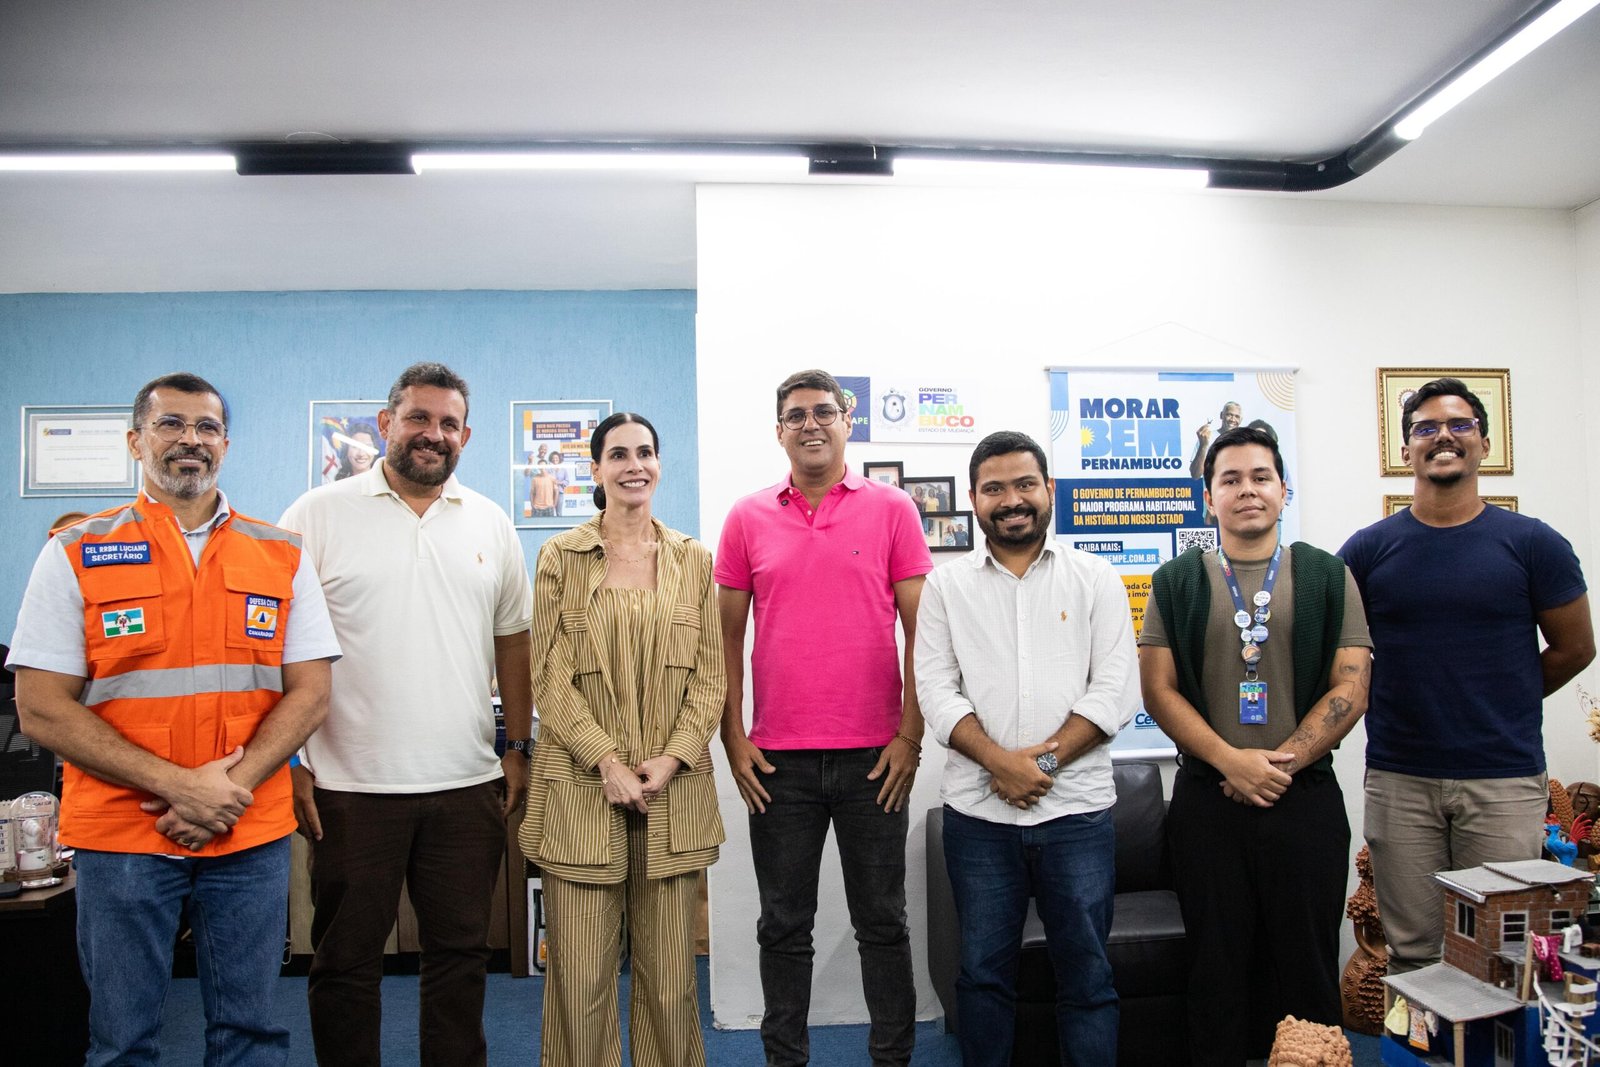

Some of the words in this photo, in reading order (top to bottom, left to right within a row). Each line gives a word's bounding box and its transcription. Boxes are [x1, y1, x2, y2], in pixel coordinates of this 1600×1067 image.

[919, 393, 957, 404] PER
[919, 404, 963, 415] NAM
[1080, 398, 1180, 418] MORAR
[919, 416, 974, 427] BUCO
[1080, 420, 1182, 457] BEM
[1082, 458, 1182, 470] PERNAMBUCO
[1073, 488, 1078, 499] O
[1080, 488, 1114, 499] GOVERNO
[1115, 488, 1124, 498] DE
[1126, 488, 1174, 498] PERNAMBUCO
[1176, 488, 1191, 498] COM
[1074, 502, 1079, 512] O
[1080, 502, 1103, 512] MAIOR
[1105, 501, 1144, 512] PROGRAMA
[1146, 501, 1196, 511] HABITACIONAL
[1074, 515, 1083, 525] DA
[1085, 513, 1118, 525] HISTÓRIA
[1119, 514, 1130, 525] DO
[1131, 514, 1155, 525] NOSSO
[1156, 514, 1184, 524] ESTADO
[1079, 543, 1100, 552] SAIBA
[1100, 543, 1121, 552] MAIS:
[92, 551, 143, 561] SECRETÁRIO
[250, 597, 266, 606] DEFESA
[267, 599, 278, 608] CIVIL
